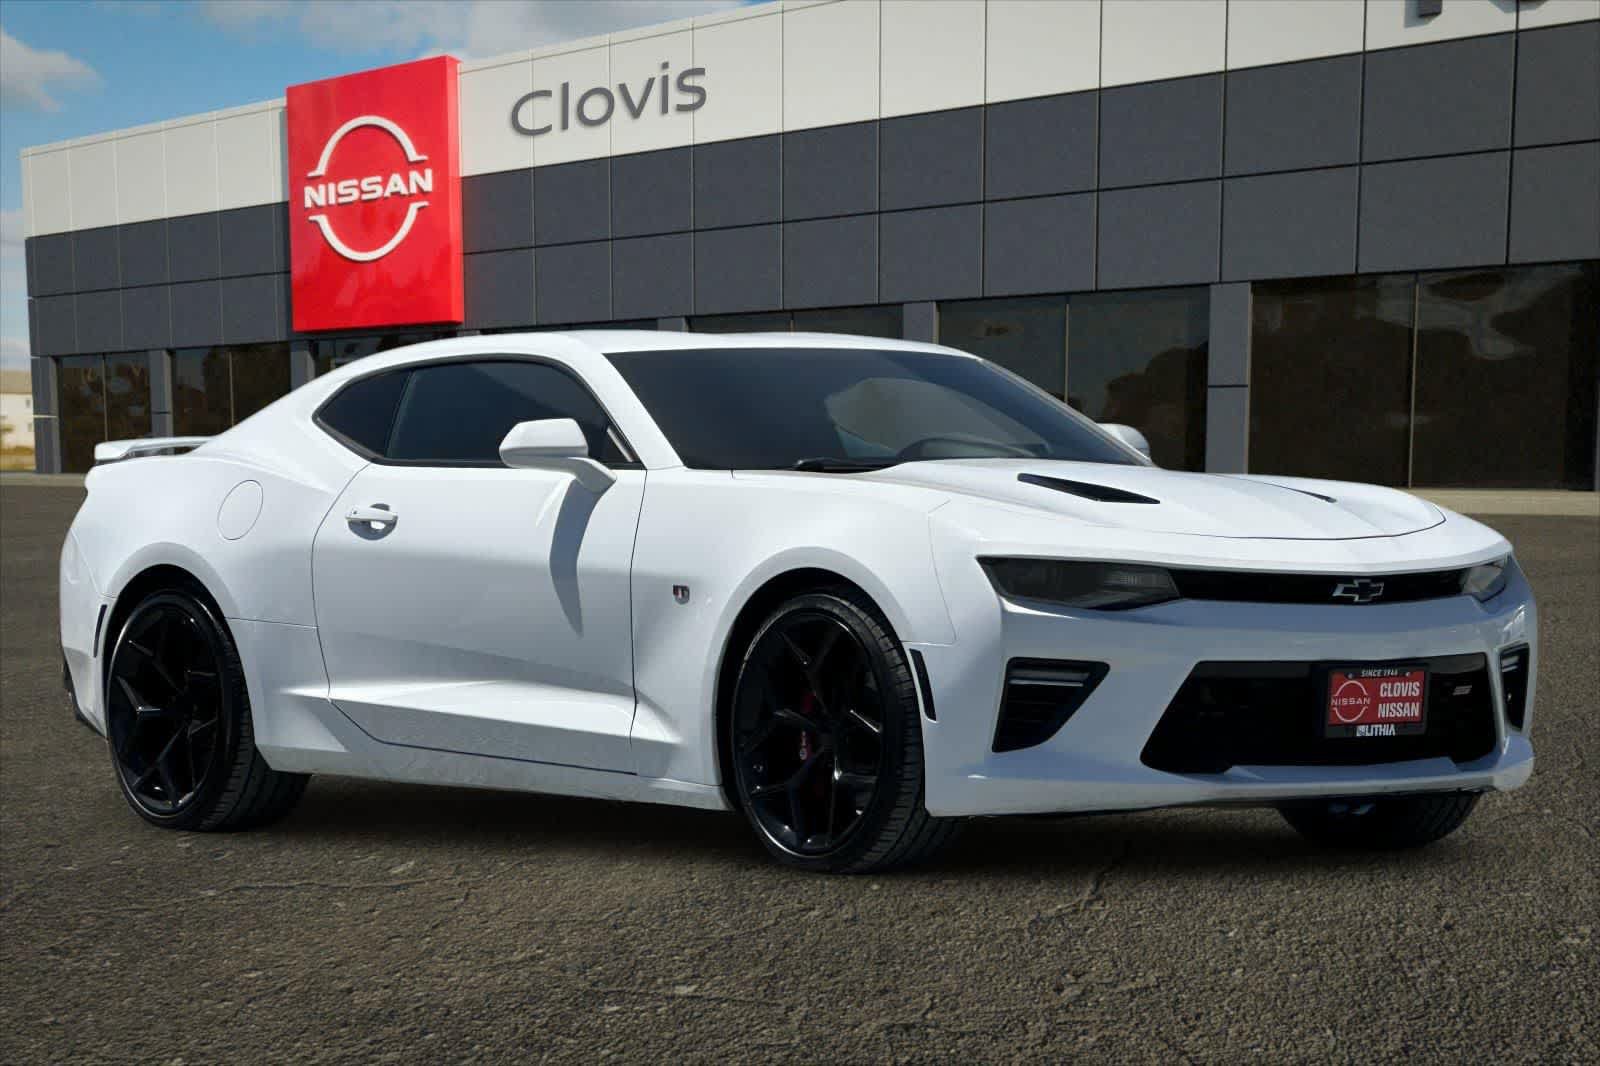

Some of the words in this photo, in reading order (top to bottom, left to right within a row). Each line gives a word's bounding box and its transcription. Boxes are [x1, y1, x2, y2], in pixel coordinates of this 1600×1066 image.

[511, 62, 708, 136] Clovis
[304, 168, 433, 208] NISSAN
[1361, 669, 1381, 677] SINCE
[1380, 681, 1420, 697] CLOVIS
[1331, 697, 1371, 705] NISSAN
[1377, 702, 1419, 718] NISSAN
[1365, 724, 1396, 736] LITHIA
